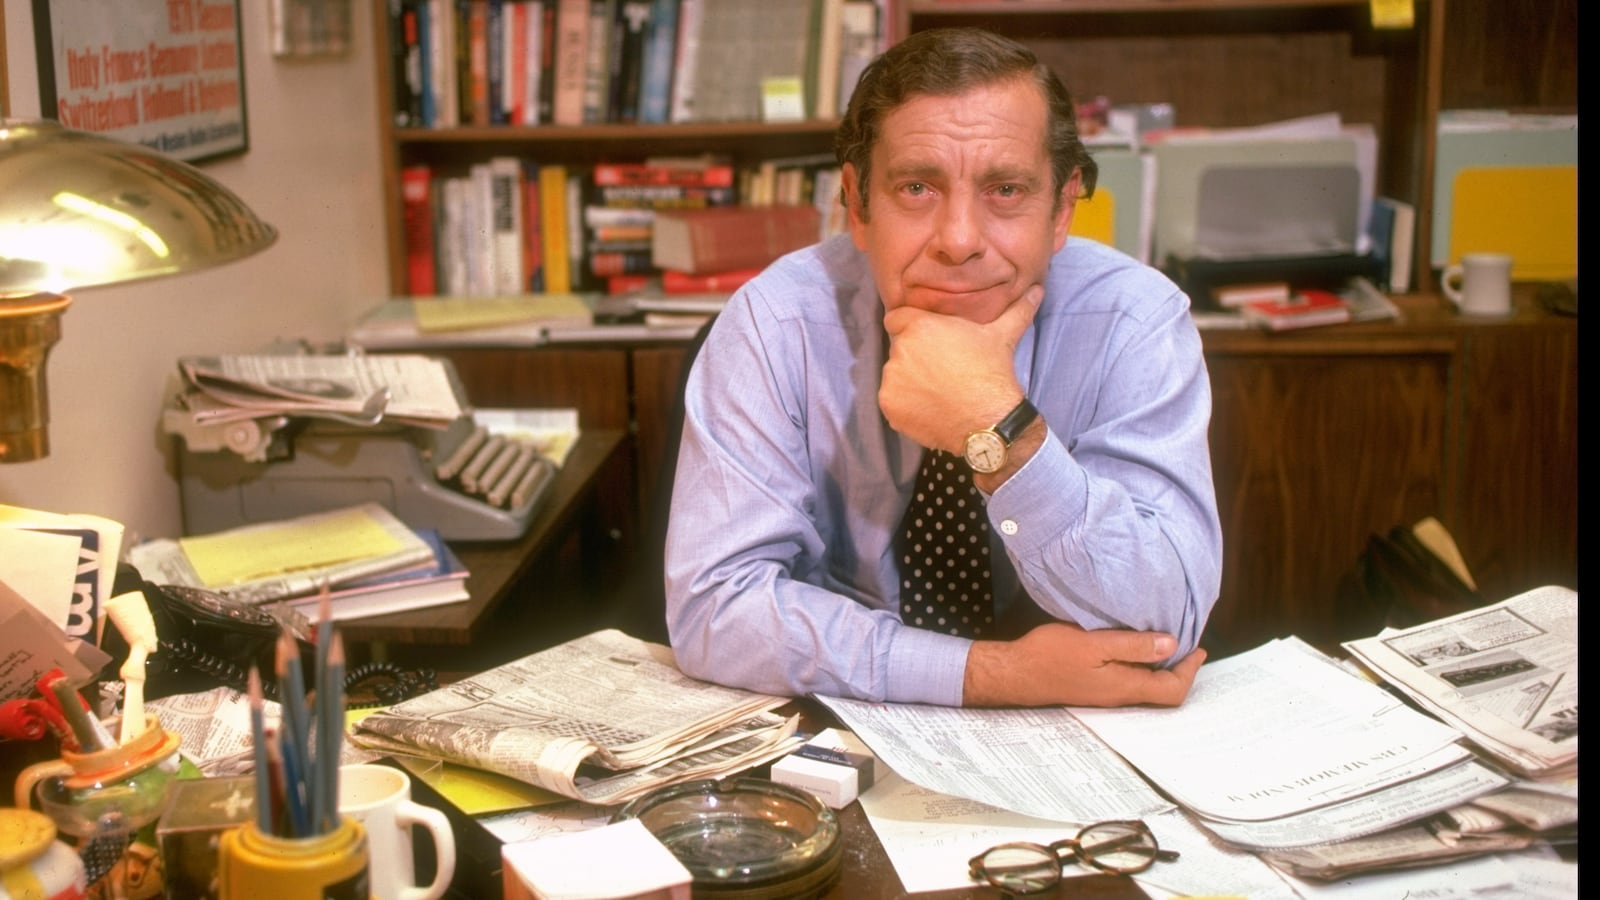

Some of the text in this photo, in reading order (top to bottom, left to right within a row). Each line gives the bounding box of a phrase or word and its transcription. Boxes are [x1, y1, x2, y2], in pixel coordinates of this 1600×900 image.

[67, 47, 99, 91] Italy
[103, 45, 147, 85] France
[58, 89, 140, 131] Switzerland
[1370, 745, 1408, 762] CBS
[1227, 760, 1368, 802] MEMORANDUM
